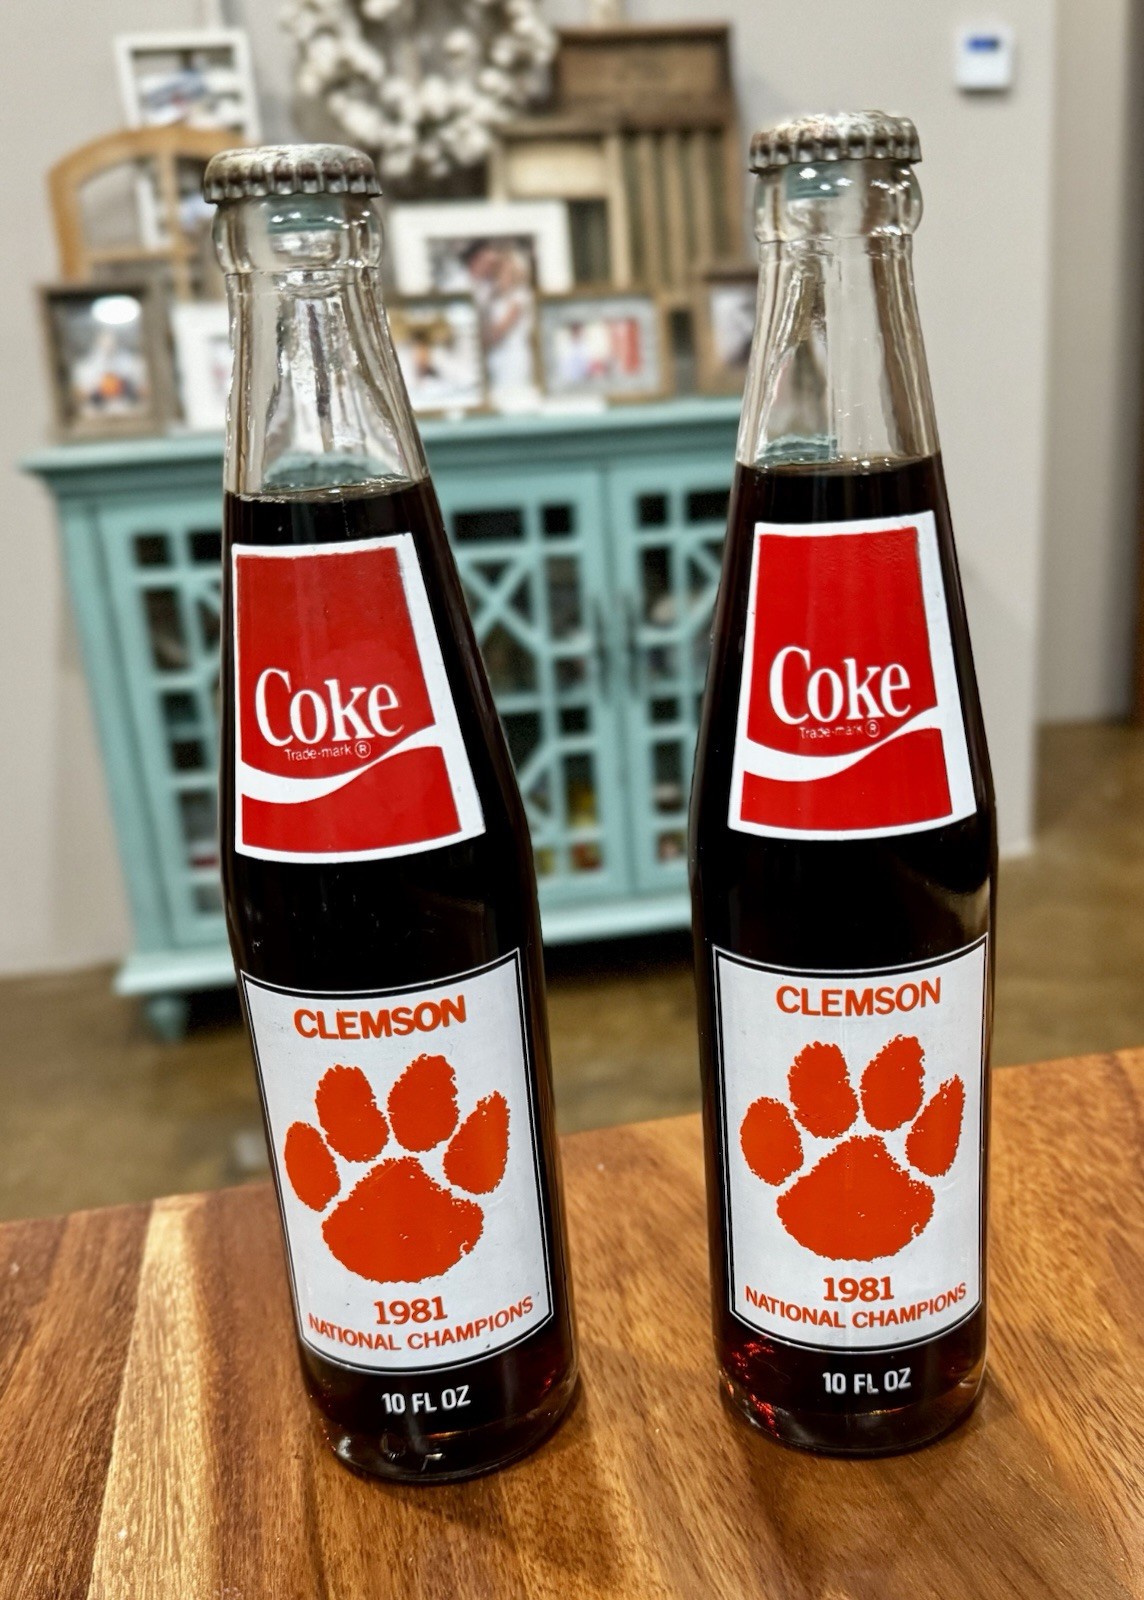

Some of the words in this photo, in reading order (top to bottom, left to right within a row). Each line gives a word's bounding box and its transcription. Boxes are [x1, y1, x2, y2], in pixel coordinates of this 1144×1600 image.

[769, 646, 911, 725] Coke
[255, 667, 404, 747] Coke
[284, 744, 352, 761] Trade-mark
[294, 994, 467, 1040] CLEMSON
[776, 977, 941, 1017] CLEMSON
[745, 1285, 846, 1328] NATIONAL
[852, 1282, 967, 1329] CHAMPIONS
[823, 1276, 894, 1302] 1981
[308, 1312, 402, 1351] NATIONAL
[407, 1296, 534, 1350] CHAMPIONS
[374, 1296, 448, 1325] 1981
[381, 1392, 406, 1414] 10
[412, 1393, 438, 1414] FL
[441, 1385, 471, 1410] OZ
[822, 1372, 847, 1394] 10
[854, 1373, 879, 1394] FL
[884, 1367, 912, 1391] OZ
